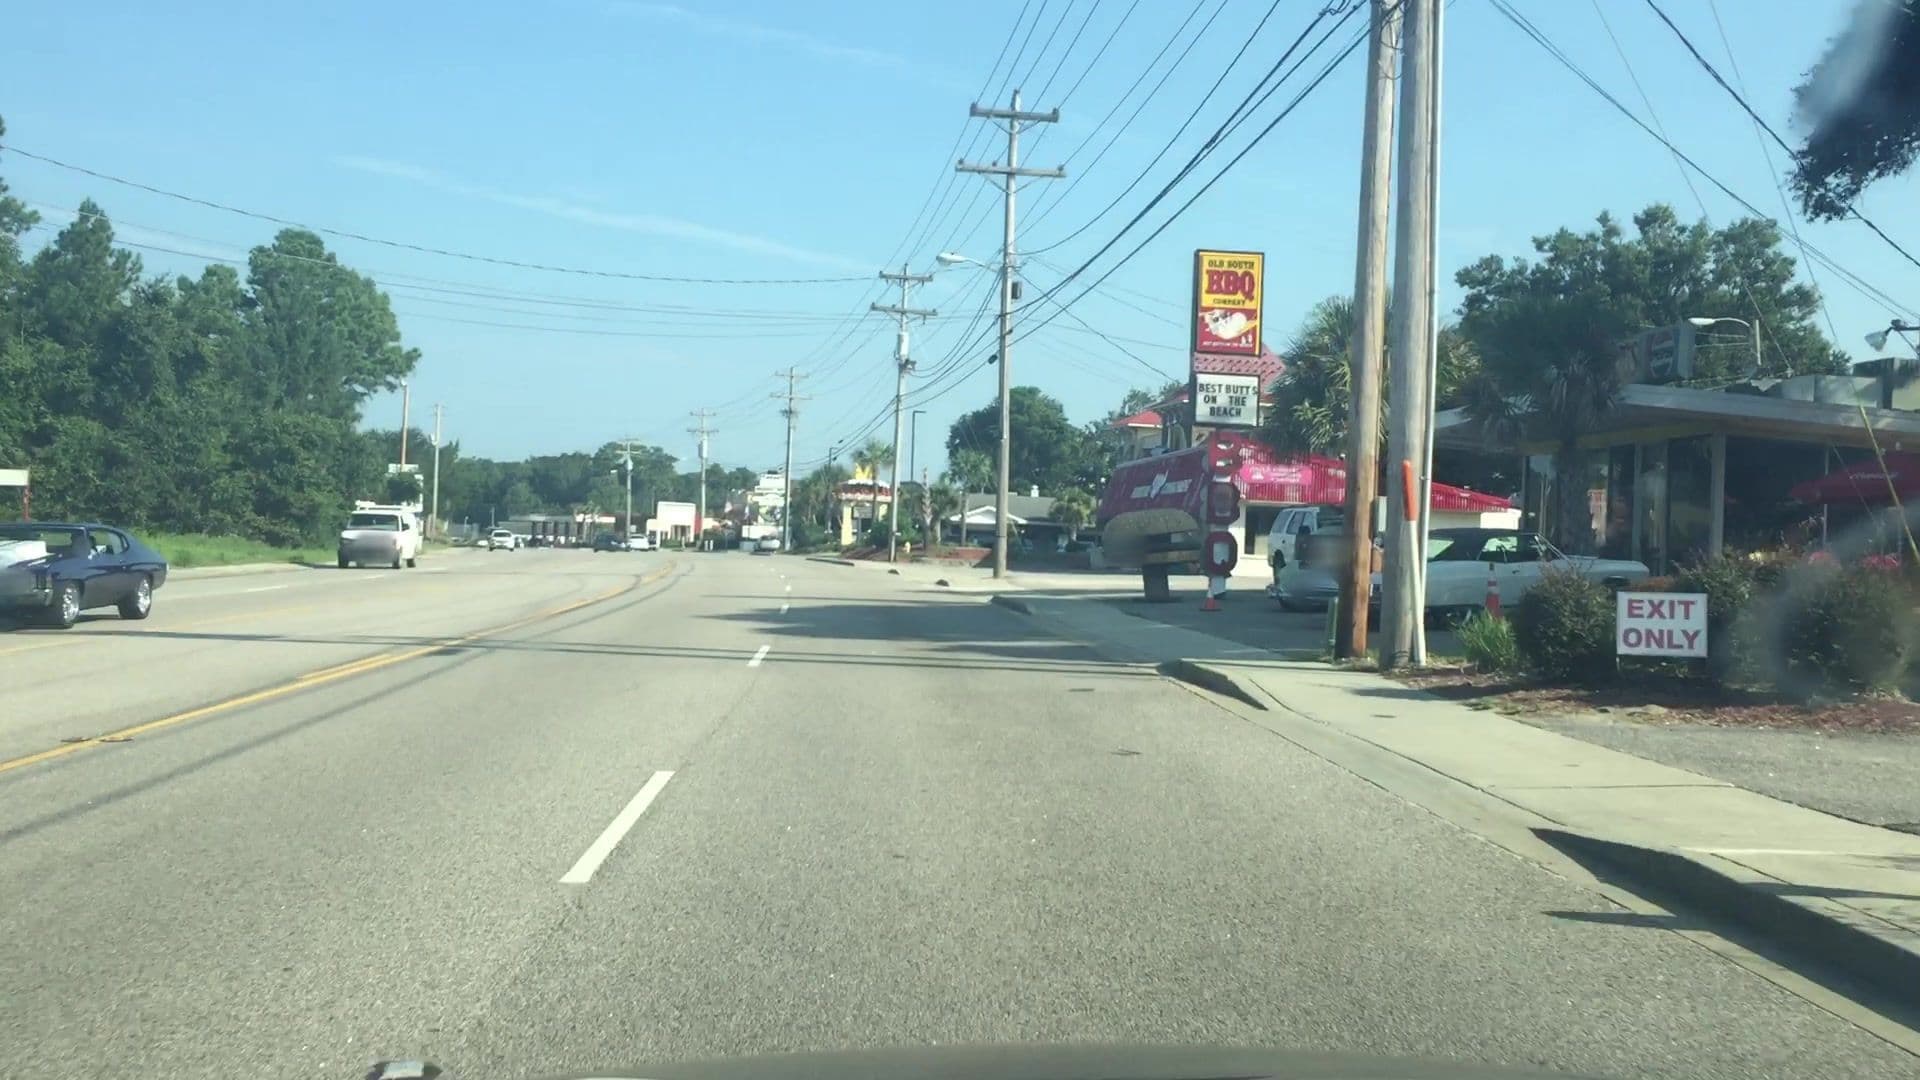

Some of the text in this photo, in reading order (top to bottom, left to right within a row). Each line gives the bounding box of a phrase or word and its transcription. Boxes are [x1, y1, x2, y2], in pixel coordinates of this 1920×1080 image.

[1208, 260, 1255, 269] OLD SOUTH
[1205, 269, 1256, 302] BBQ
[1199, 383, 1258, 395] BEST BUTTS
[1204, 395, 1247, 406] ON THE
[1209, 406, 1241, 417] BEACH
[1627, 599, 1696, 620] EXIT
[1622, 628, 1701, 650] ONLY
